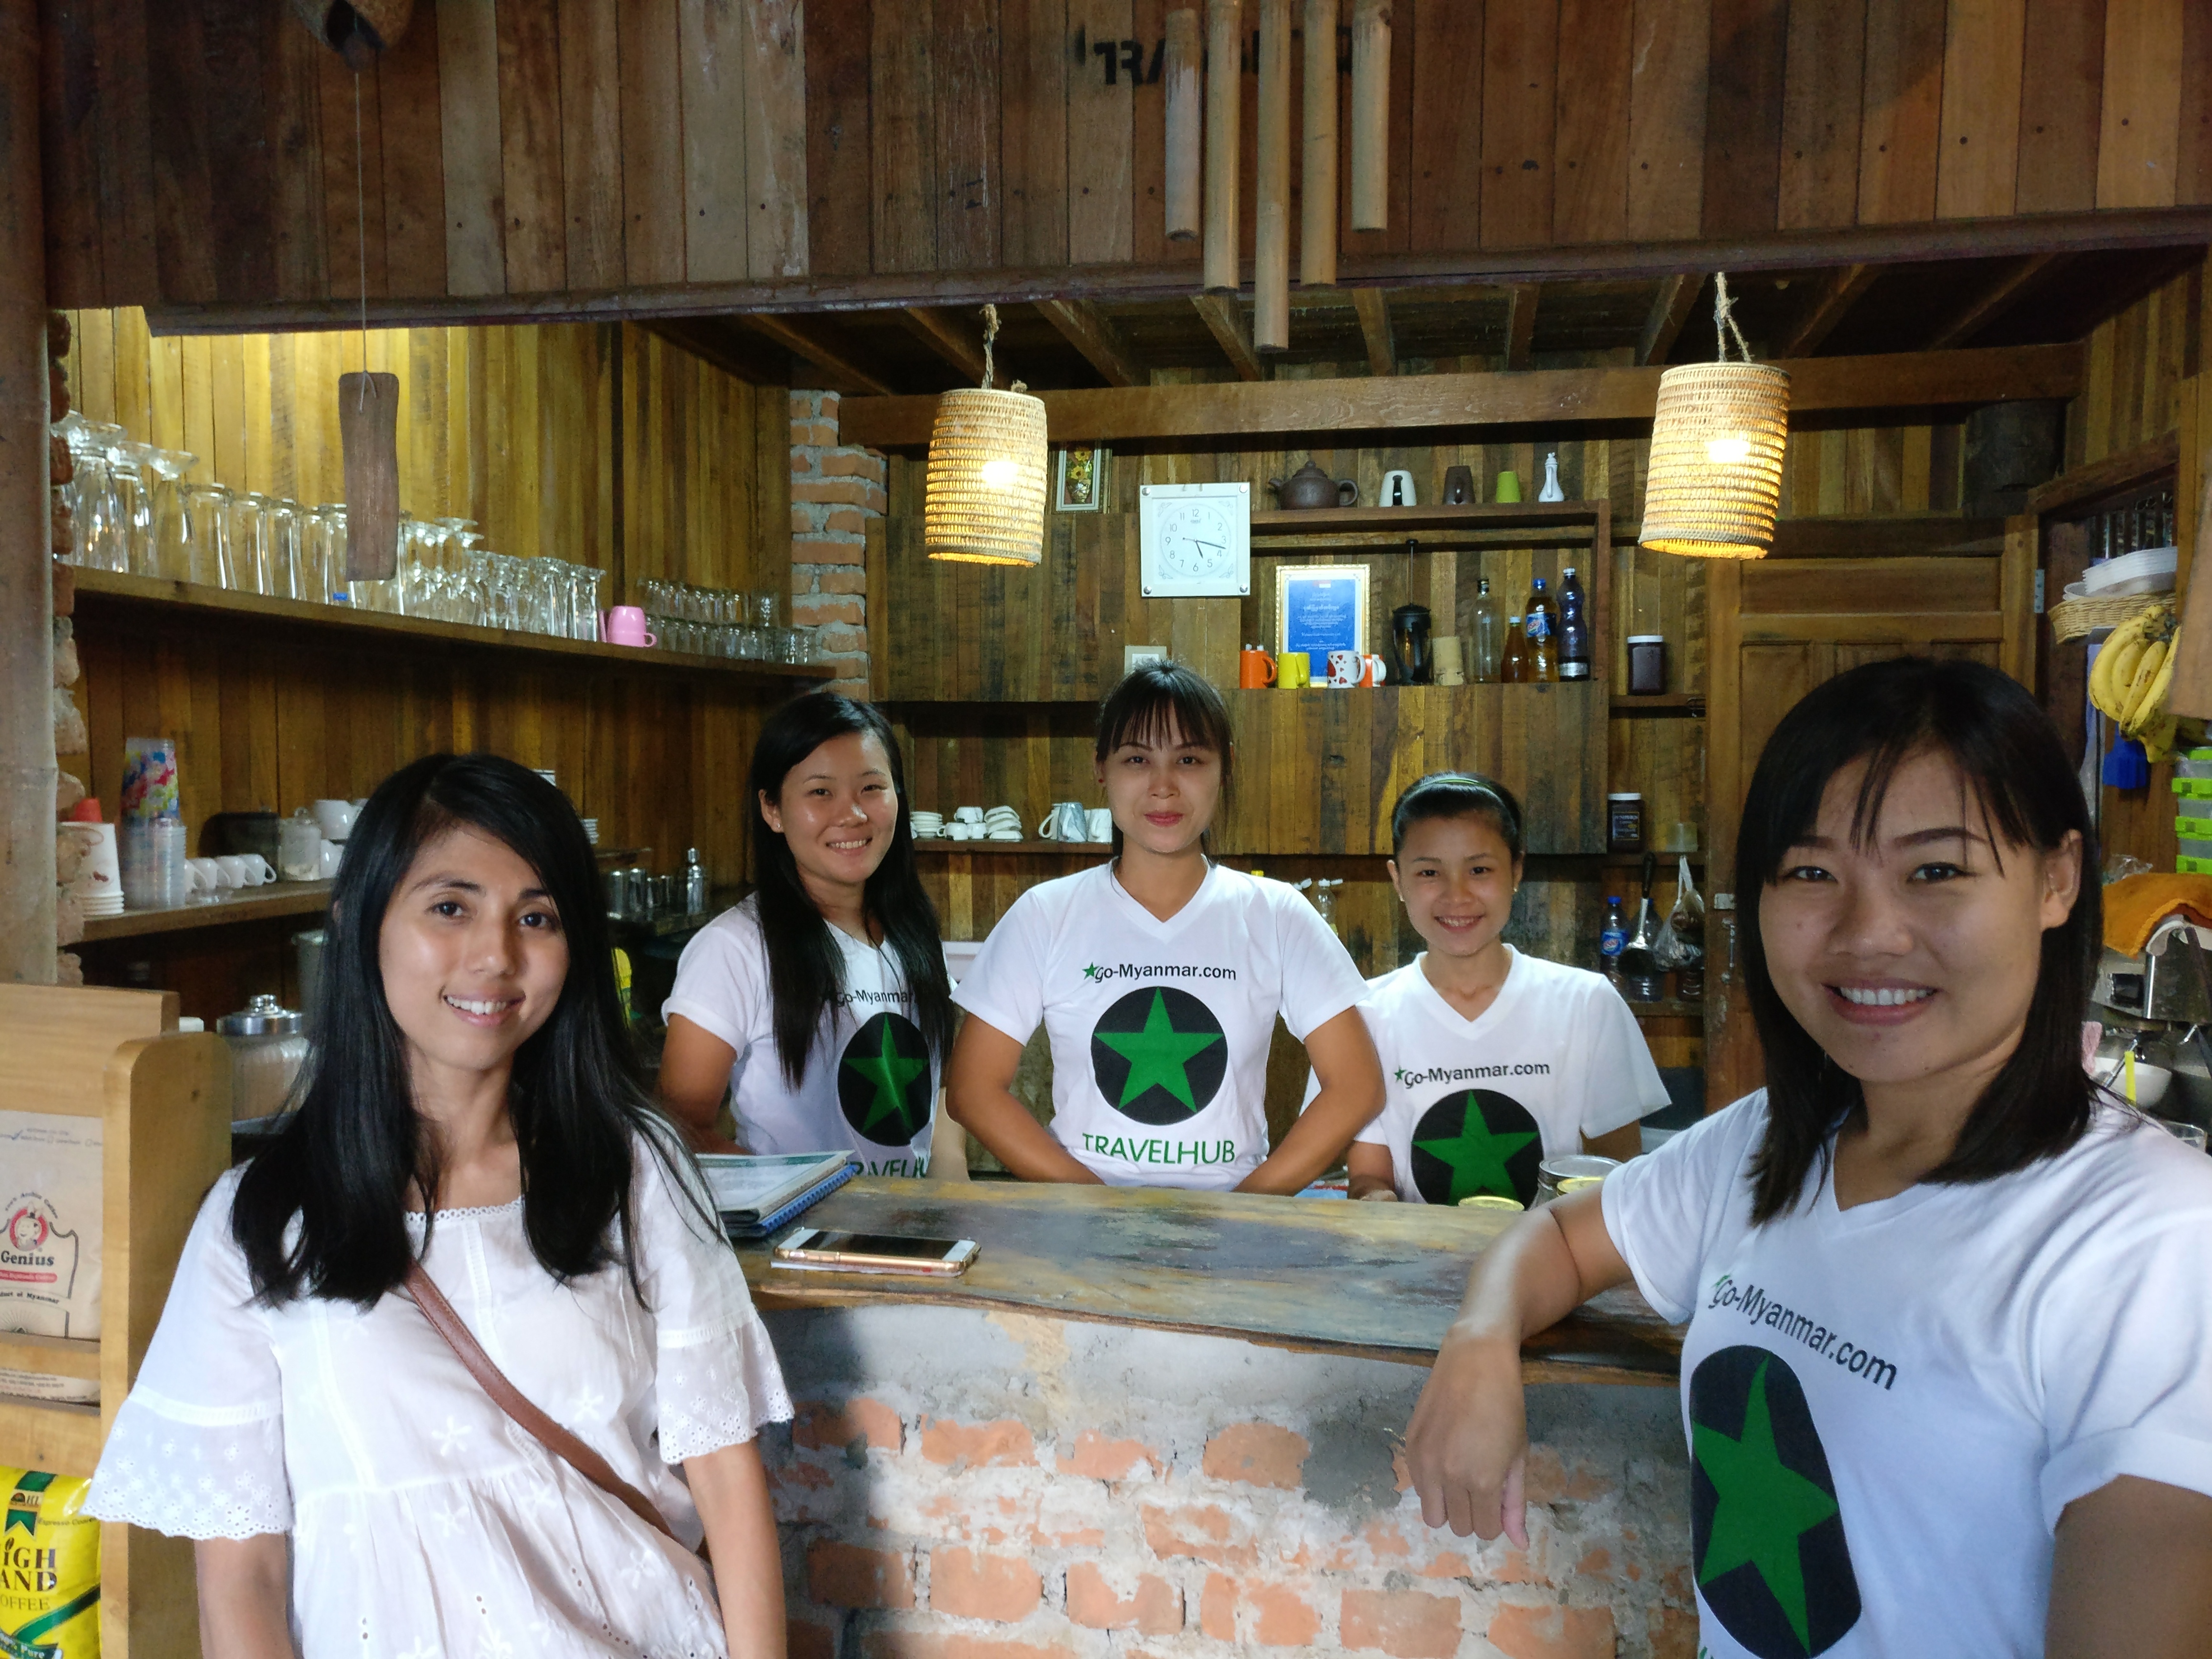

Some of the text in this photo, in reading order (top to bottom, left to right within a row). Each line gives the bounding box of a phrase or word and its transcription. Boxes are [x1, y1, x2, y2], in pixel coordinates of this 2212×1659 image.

[1180, 512, 1185, 521] 11
[1192, 508, 1199, 517] 12
[1169, 523, 1178, 532] 10
[1217, 522, 1223, 531] 2
[1165, 536, 1171, 546] 9
[1221, 535, 1227, 544] 3
[1169, 550, 1176, 559] 8
[1179, 559, 1185, 568] 7
[1193, 563, 1199, 572] 6
[1207, 559, 1213, 568] 5
[1404, 1063, 1550, 1089] Go-Myanmar.com
[1082, 1133, 1236, 1165] TRAVELHUB
[1, 1250, 55, 1266] Genius
[1708, 1279, 1897, 1391] Go-Myanmar.com
[0, 1569, 57, 1592] AND
[0, 1595, 51, 1610] OFFEE
